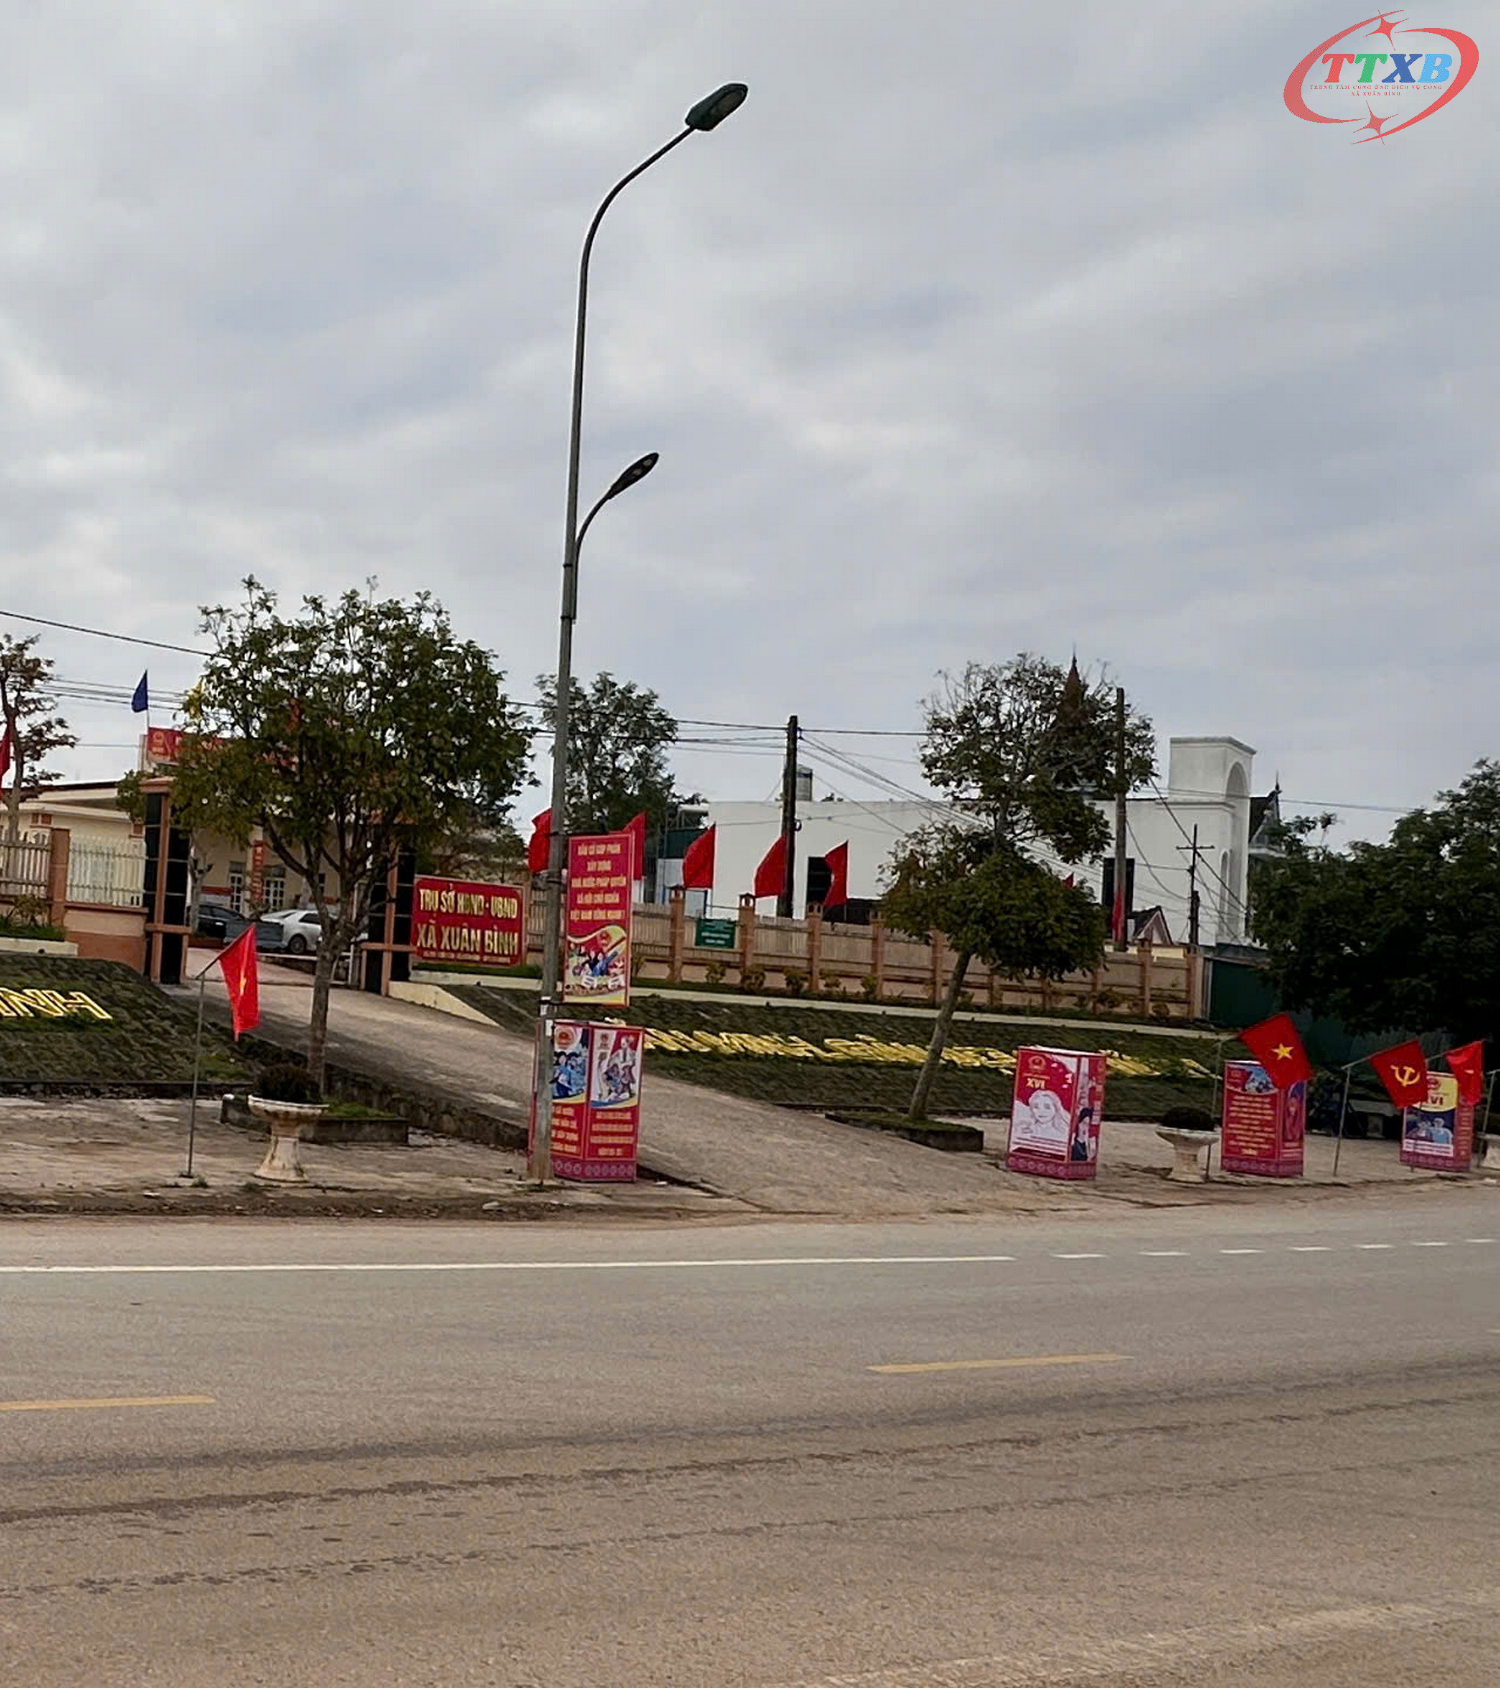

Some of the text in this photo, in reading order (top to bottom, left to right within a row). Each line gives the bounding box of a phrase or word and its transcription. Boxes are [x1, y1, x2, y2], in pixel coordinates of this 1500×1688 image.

[419, 888, 439, 917] TRỤ
[440, 882, 456, 913] SỞ
[416, 918, 519, 955] XÃ XUÂN BÌNH
[1025, 1077, 1046, 1089] XVI
